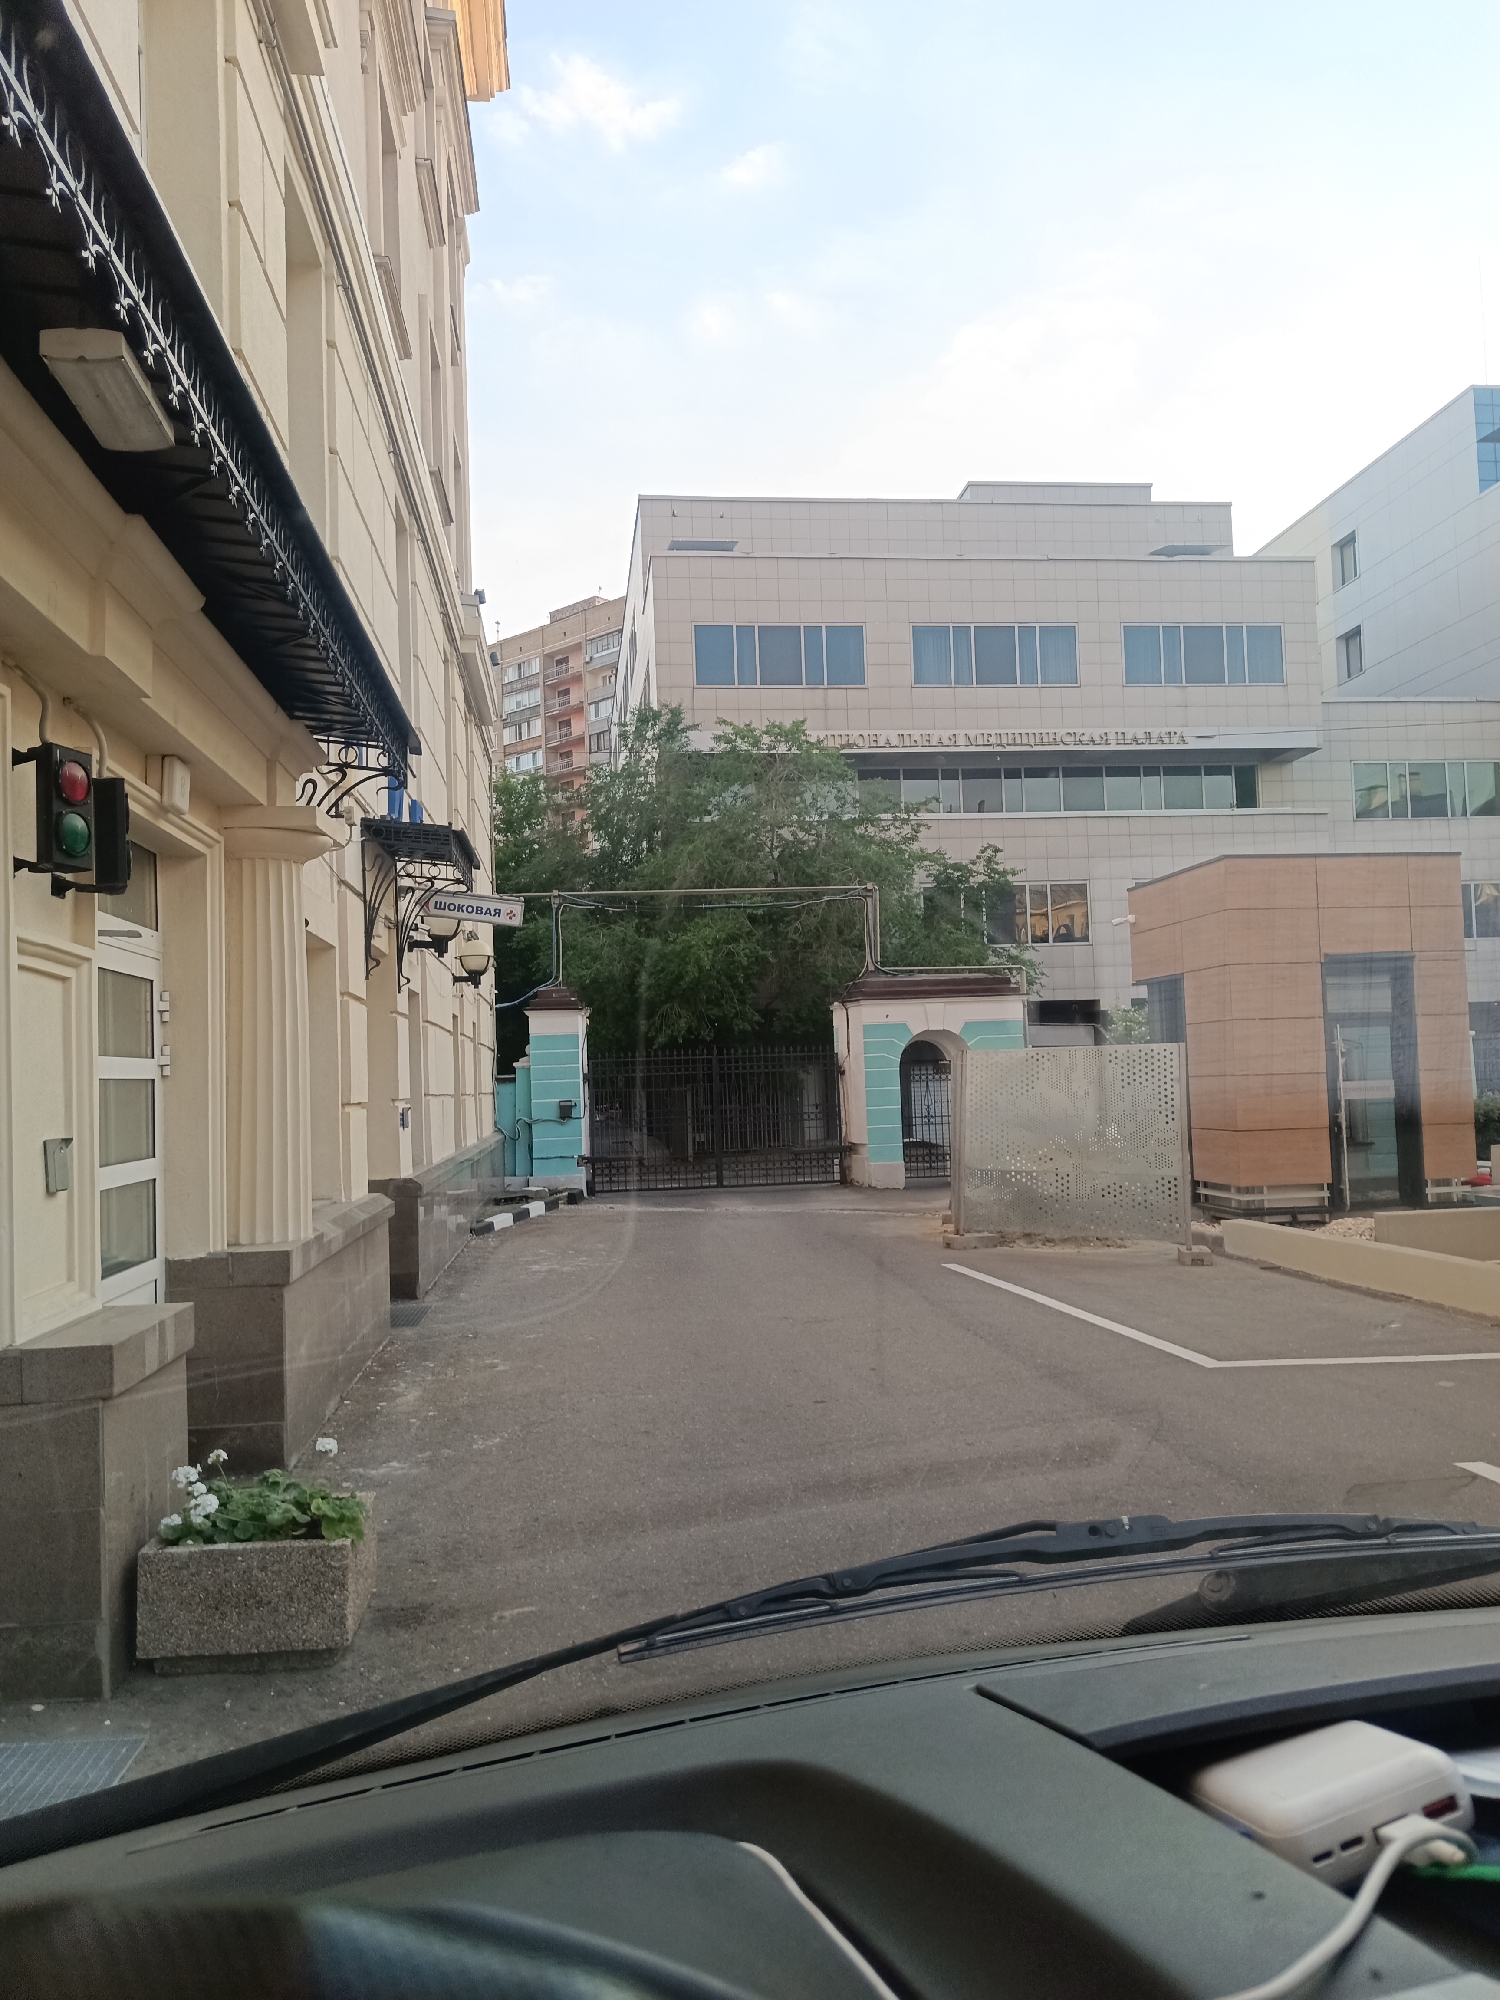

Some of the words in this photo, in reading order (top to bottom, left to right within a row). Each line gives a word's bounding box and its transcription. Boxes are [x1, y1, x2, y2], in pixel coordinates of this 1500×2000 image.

[804, 733, 958, 748] ЦИОНАЛЬНАЯ
[963, 731, 1111, 748] МЕДИЦИНСКАЯ
[1114, 730, 1189, 746] ПАЛАТА
[434, 900, 502, 917] ШОКОВАЯ
